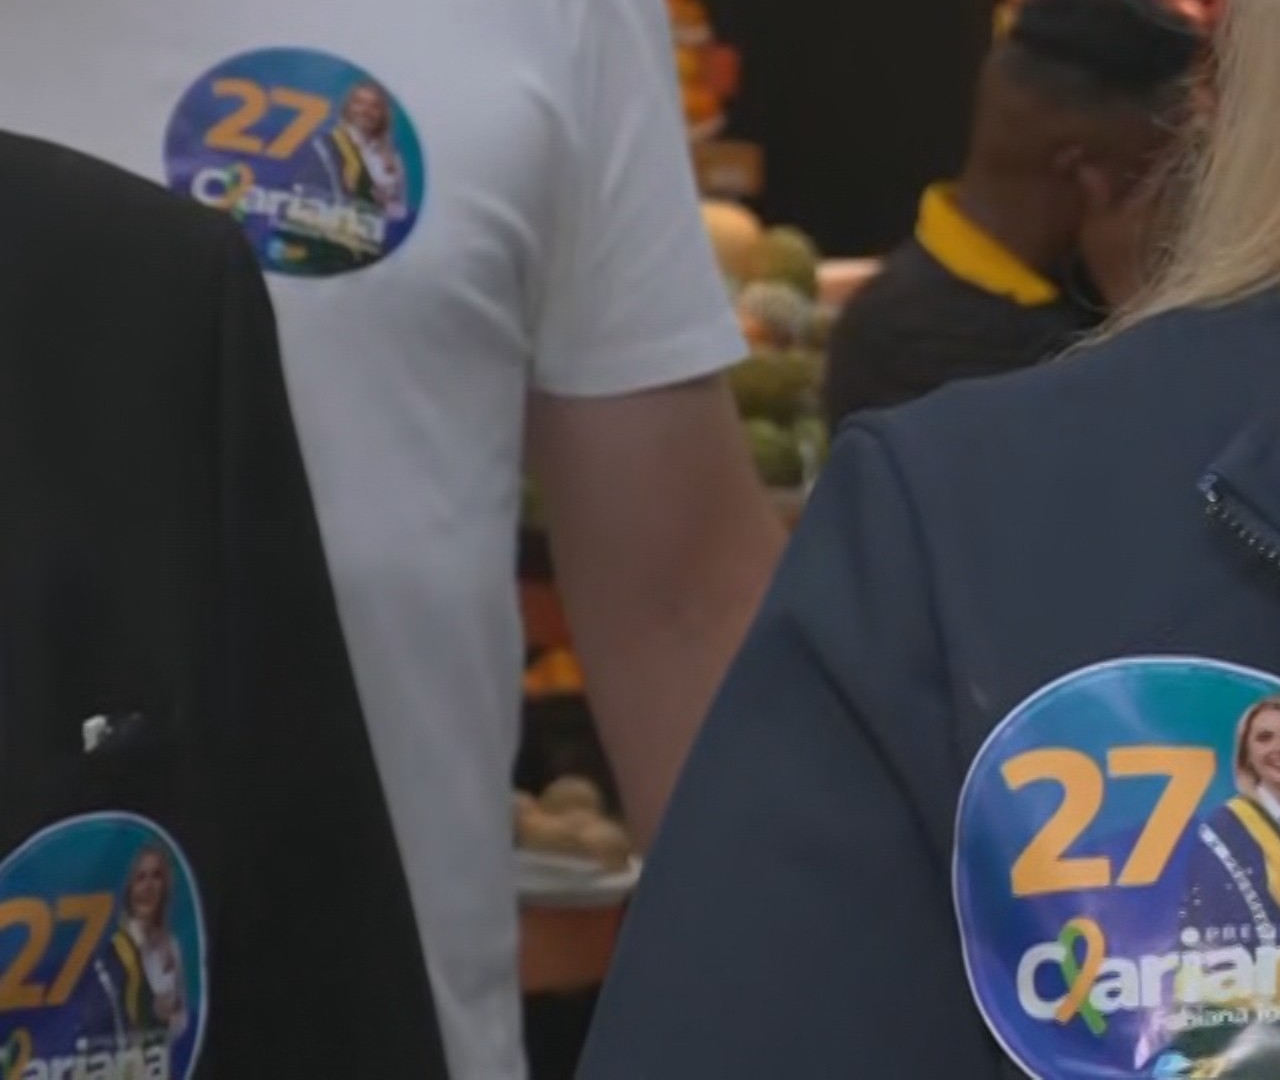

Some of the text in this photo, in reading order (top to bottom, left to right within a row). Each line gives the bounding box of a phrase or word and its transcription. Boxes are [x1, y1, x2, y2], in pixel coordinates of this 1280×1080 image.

[204, 77, 331, 160] 27
[1001, 745, 1216, 897] 27
[0, 893, 114, 1012] 27
